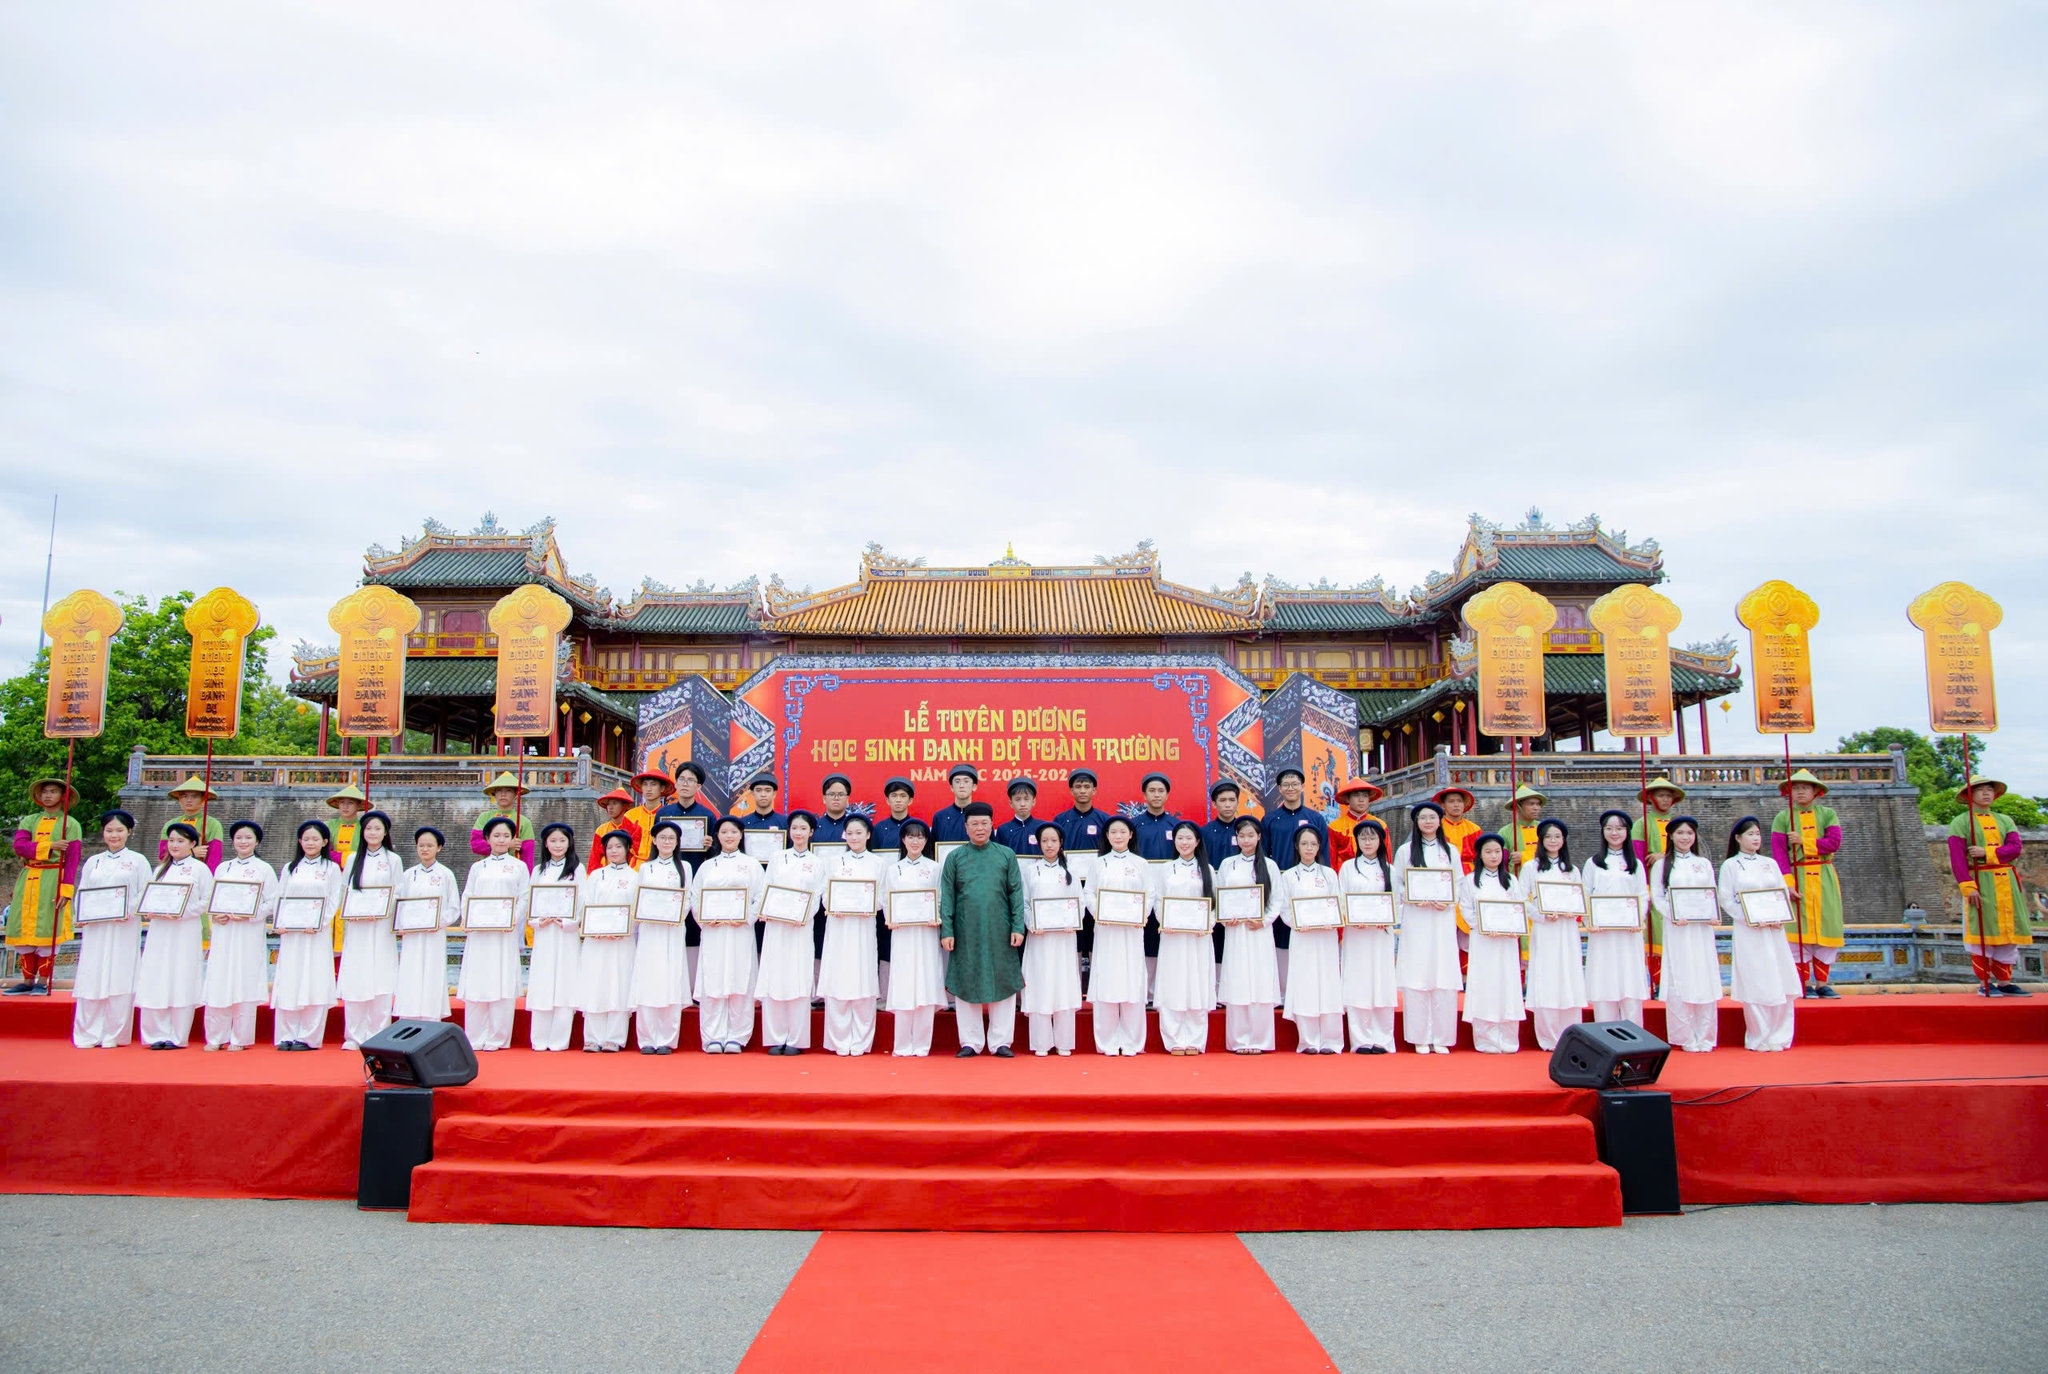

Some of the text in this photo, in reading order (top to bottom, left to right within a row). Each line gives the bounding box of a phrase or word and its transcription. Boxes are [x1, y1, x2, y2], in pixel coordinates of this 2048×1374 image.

[360, 665, 384, 676] HỌC
[515, 664, 536, 674] HỌC
[1499, 663, 1525, 674] HỌC
[1626, 664, 1651, 674] HỌC
[1772, 661, 1795, 672] HỌC
[1948, 660, 1973, 671] HỌC
[66, 666, 88, 677] HỌC
[206, 666, 225, 677] HỌC
[513, 677, 536, 686] SINH
[1499, 676, 1525, 685] SINH
[1625, 676, 1652, 686] SINH
[1773, 674, 1796, 683] SINH
[1948, 672, 1974, 682] SINH
[65, 679, 88, 689] SINH
[204, 679, 224, 688] SINH
[358, 678, 383, 687] SINH
[354, 689, 387, 699] DANH
[510, 688, 538, 699] DANH
[1496, 687, 1528, 698] DANH
[1625, 688, 1656, 699] DANH
[1771, 686, 1799, 696] DANH
[1946, 685, 1979, 694] DANH
[62, 691, 90, 701] DANH
[201, 690, 226, 700] DANH
[904, 700, 1086, 733] LỄ TUYÊN DƯƠNG
[811, 733, 1180, 768] HỌC SINH DANH DỰ TOÀN TRƯỜNG
[910, 766, 947, 782] NĂM
[992, 768, 1076, 782] 2025-202
